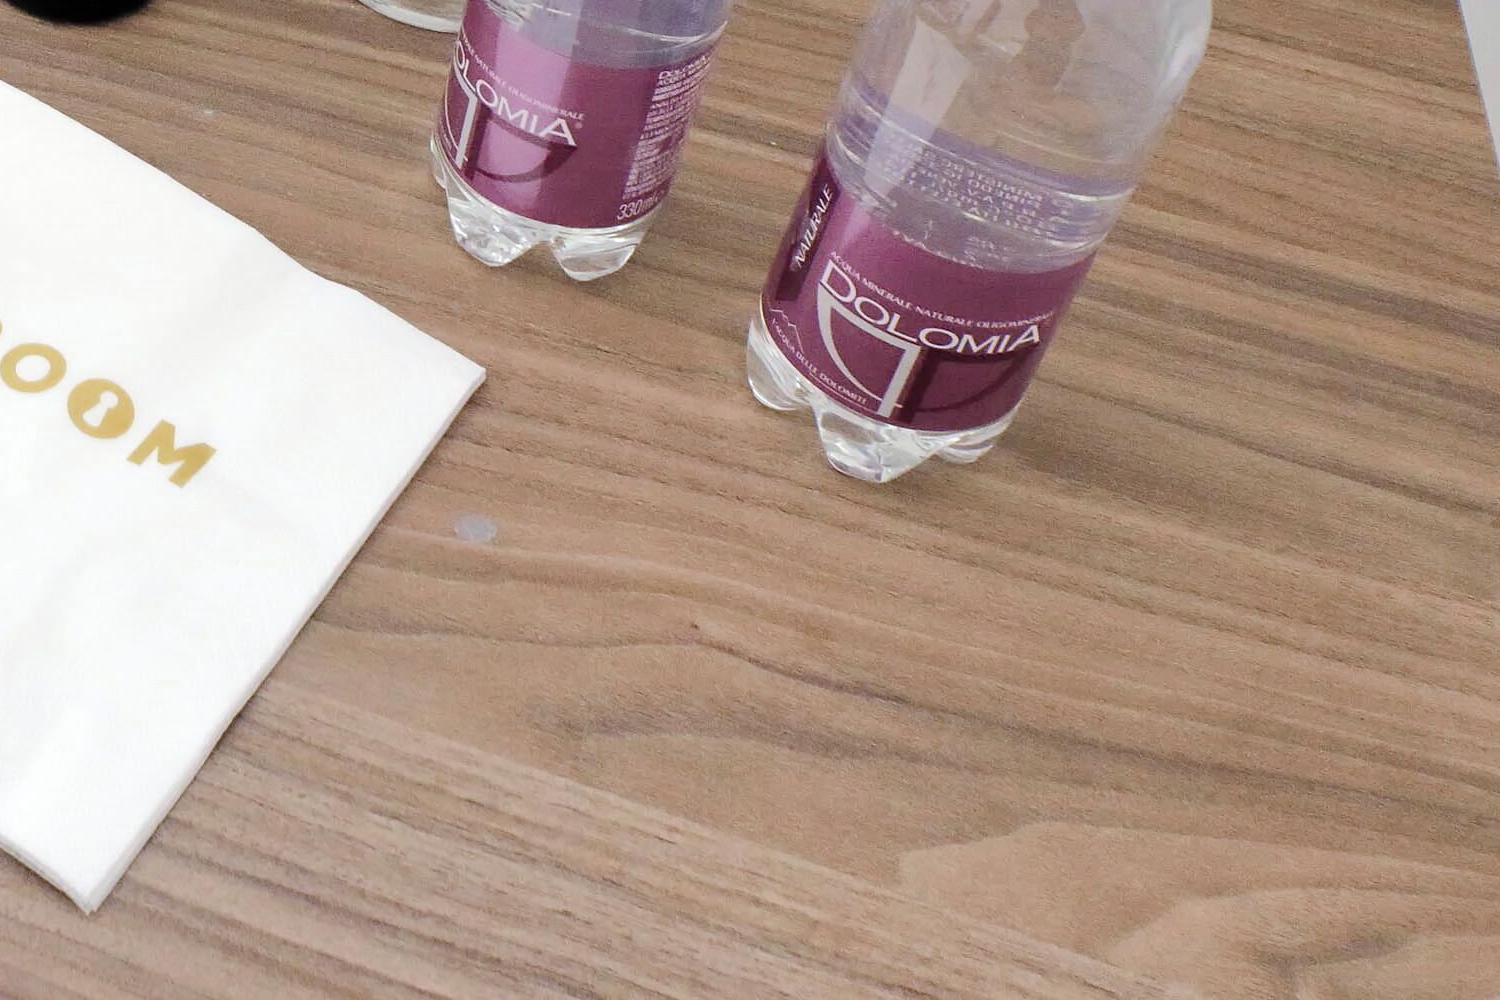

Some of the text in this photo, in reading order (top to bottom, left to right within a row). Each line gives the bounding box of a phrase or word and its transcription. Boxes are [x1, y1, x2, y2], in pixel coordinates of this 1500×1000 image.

[456, 40, 578, 147] OLOMIA
[795, 184, 833, 267] NATURALE
[820, 260, 1041, 354] DOLOMIA
[830, 251, 861, 281] ACQUA
[861, 278, 912, 310] MINERALE
[915, 306, 974, 327] NATURALE
